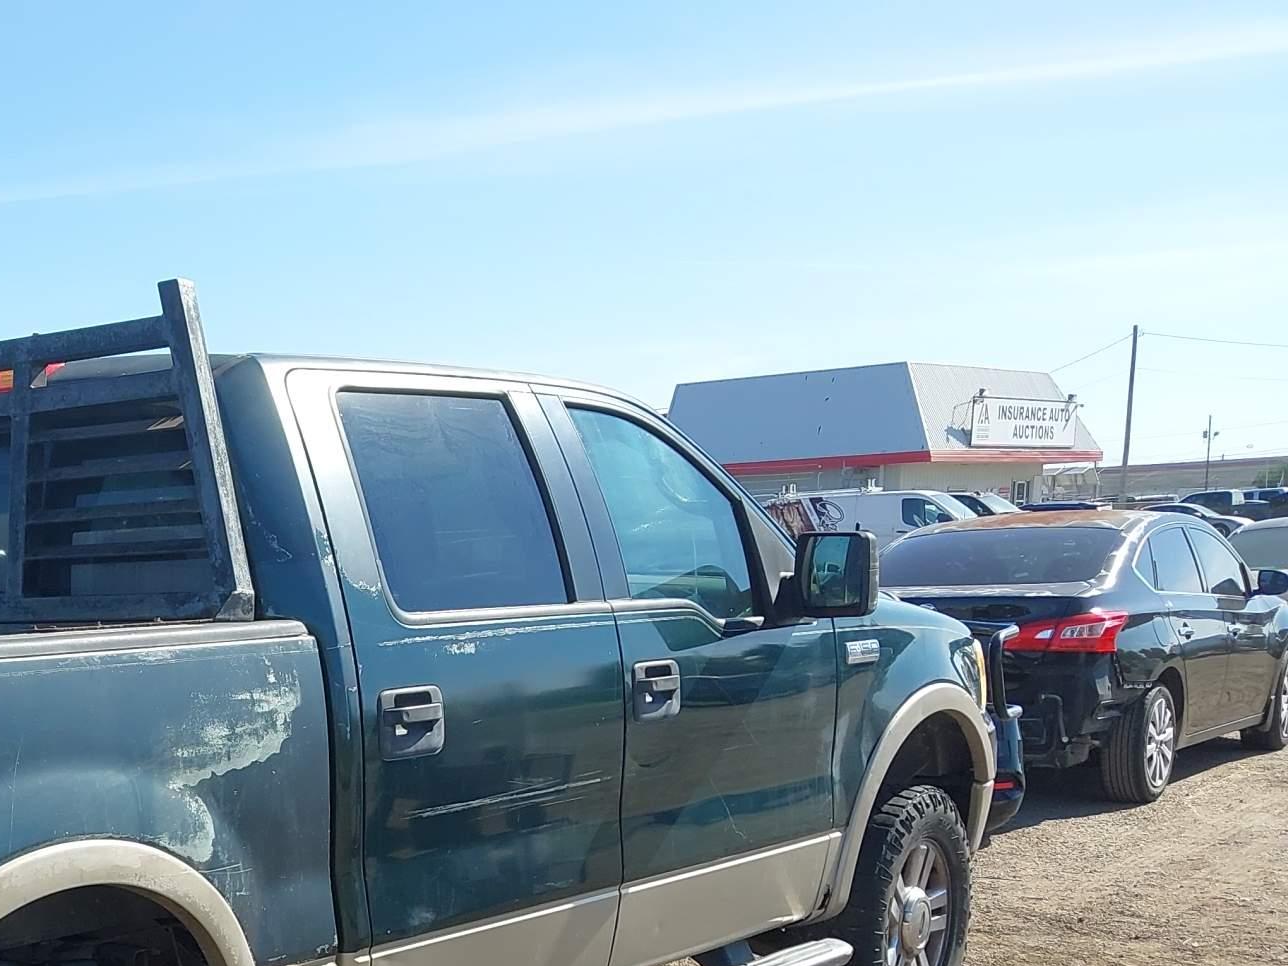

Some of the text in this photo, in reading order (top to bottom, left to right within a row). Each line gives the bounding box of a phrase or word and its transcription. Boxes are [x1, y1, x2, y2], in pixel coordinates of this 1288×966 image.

[997, 405, 1071, 422] INSURANCE AUTO
[1012, 423, 1054, 440] AUCTIONS
